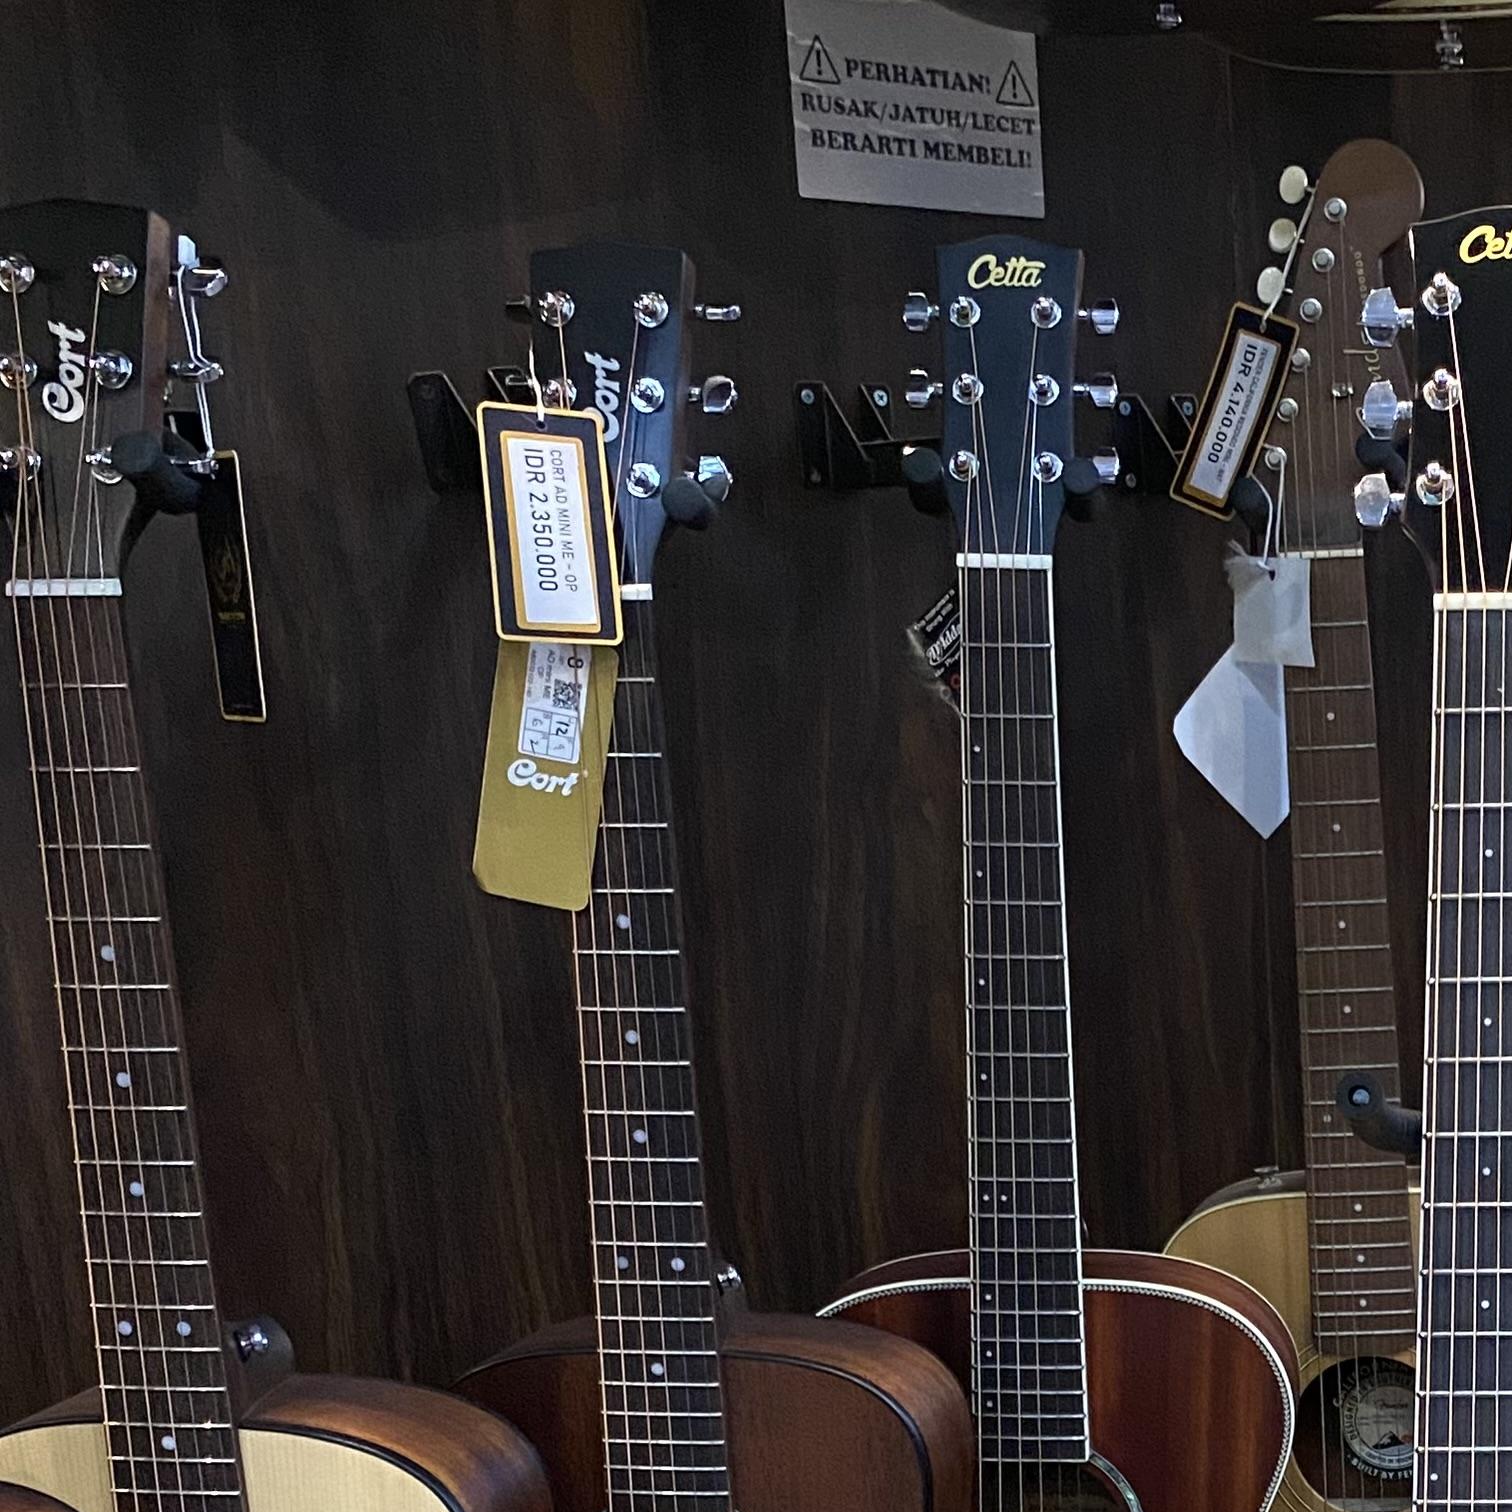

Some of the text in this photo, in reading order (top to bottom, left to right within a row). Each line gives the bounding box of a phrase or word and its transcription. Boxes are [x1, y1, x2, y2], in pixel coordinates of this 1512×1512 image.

[844, 57, 991, 95] PERHATIAN!
[801, 92, 1035, 136] RUSAK/JATUH/LECET
[810, 128, 1032, 169] BERARTI MEMBELI!
[968, 254, 1046, 289] Cetta
[42, 320, 86, 423] Cort
[1208, 344, 1257, 463] IDR 4.140.000
[550, 450, 565, 481] CORT
[555, 485, 566, 505] AD
[524, 448, 558, 592] IDR 2.350.000
[557, 507, 571, 539] MINI
[561, 542, 575, 560] ME
[564, 574, 578, 592] OP
[507, 758, 579, 796] Cort
